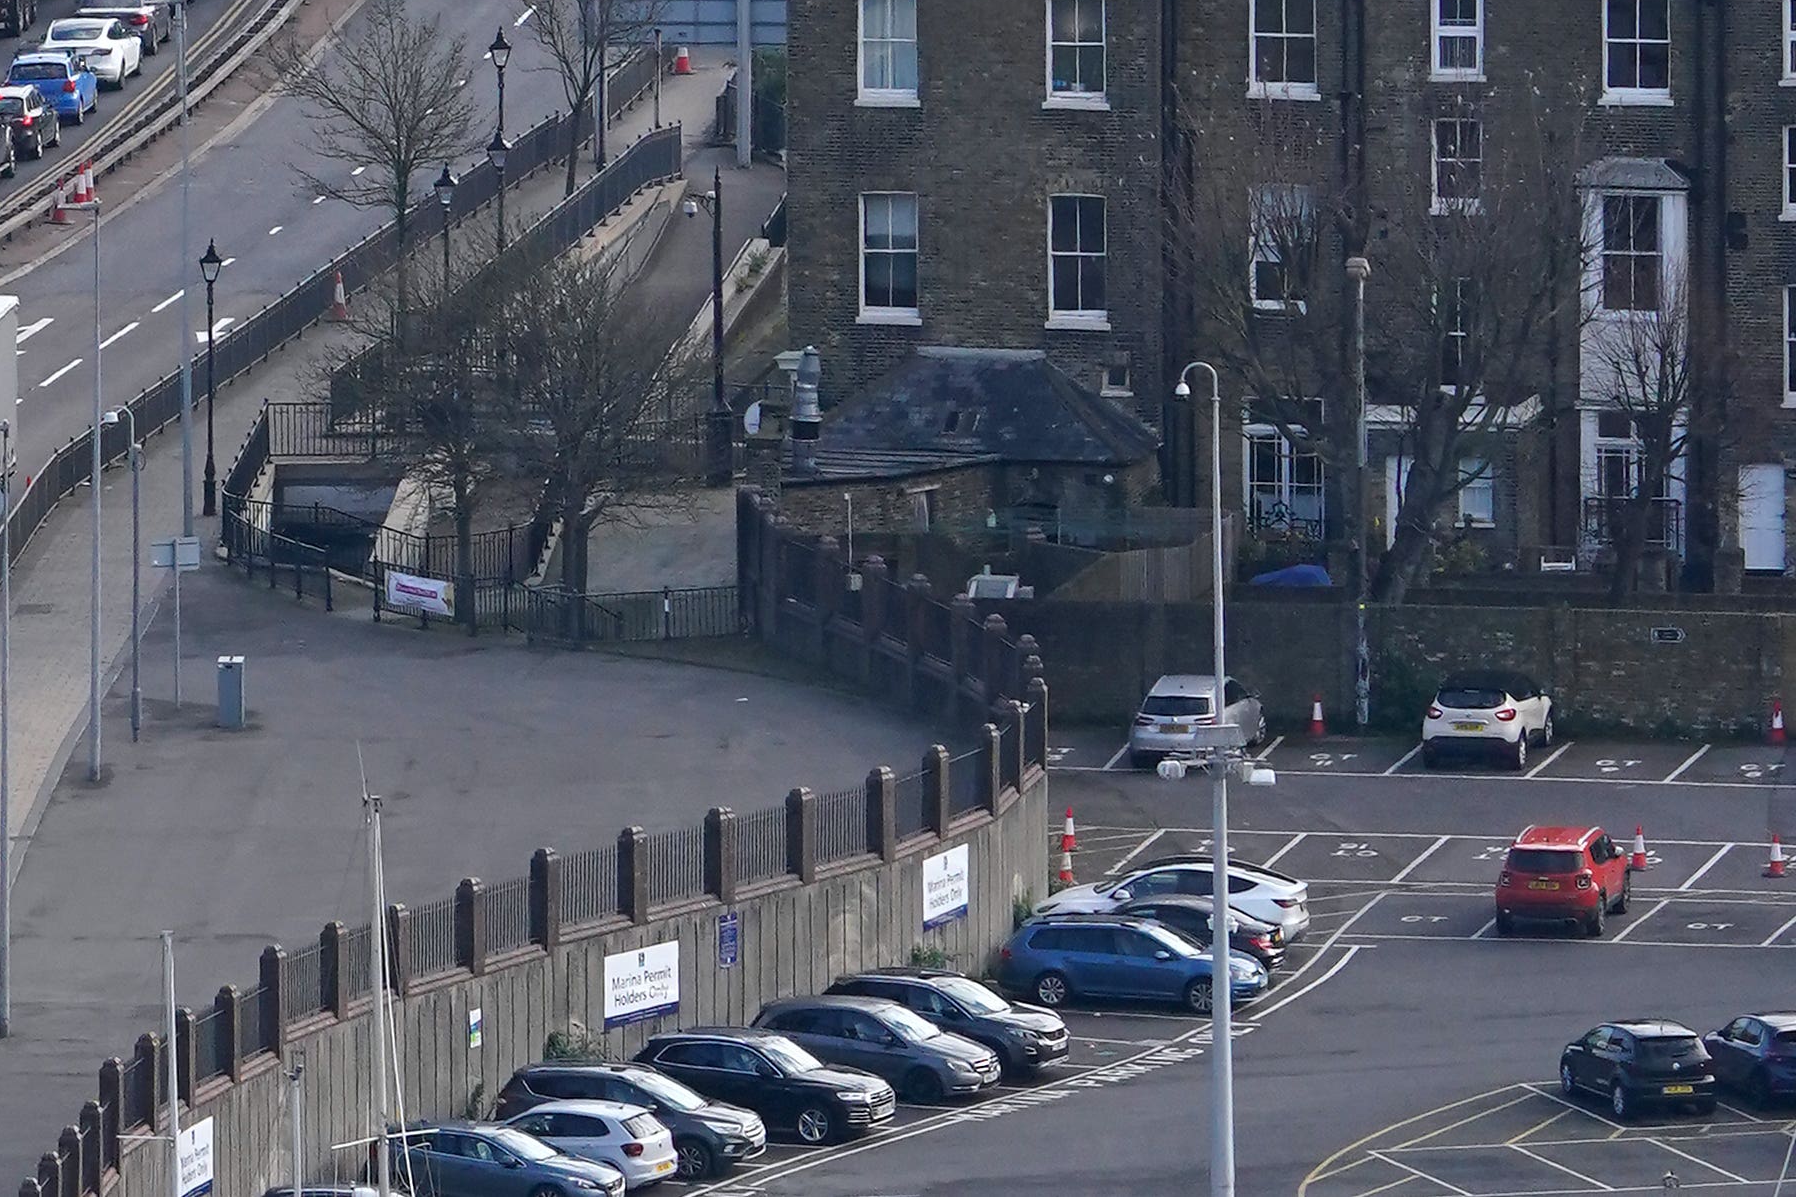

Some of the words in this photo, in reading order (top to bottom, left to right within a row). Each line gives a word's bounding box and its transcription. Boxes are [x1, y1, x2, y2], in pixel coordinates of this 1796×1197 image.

[612, 972, 642, 991] Marina
[644, 965, 672, 983] Permit
[614, 989, 647, 1008] Holders
[649, 983, 669, 1000] Only
